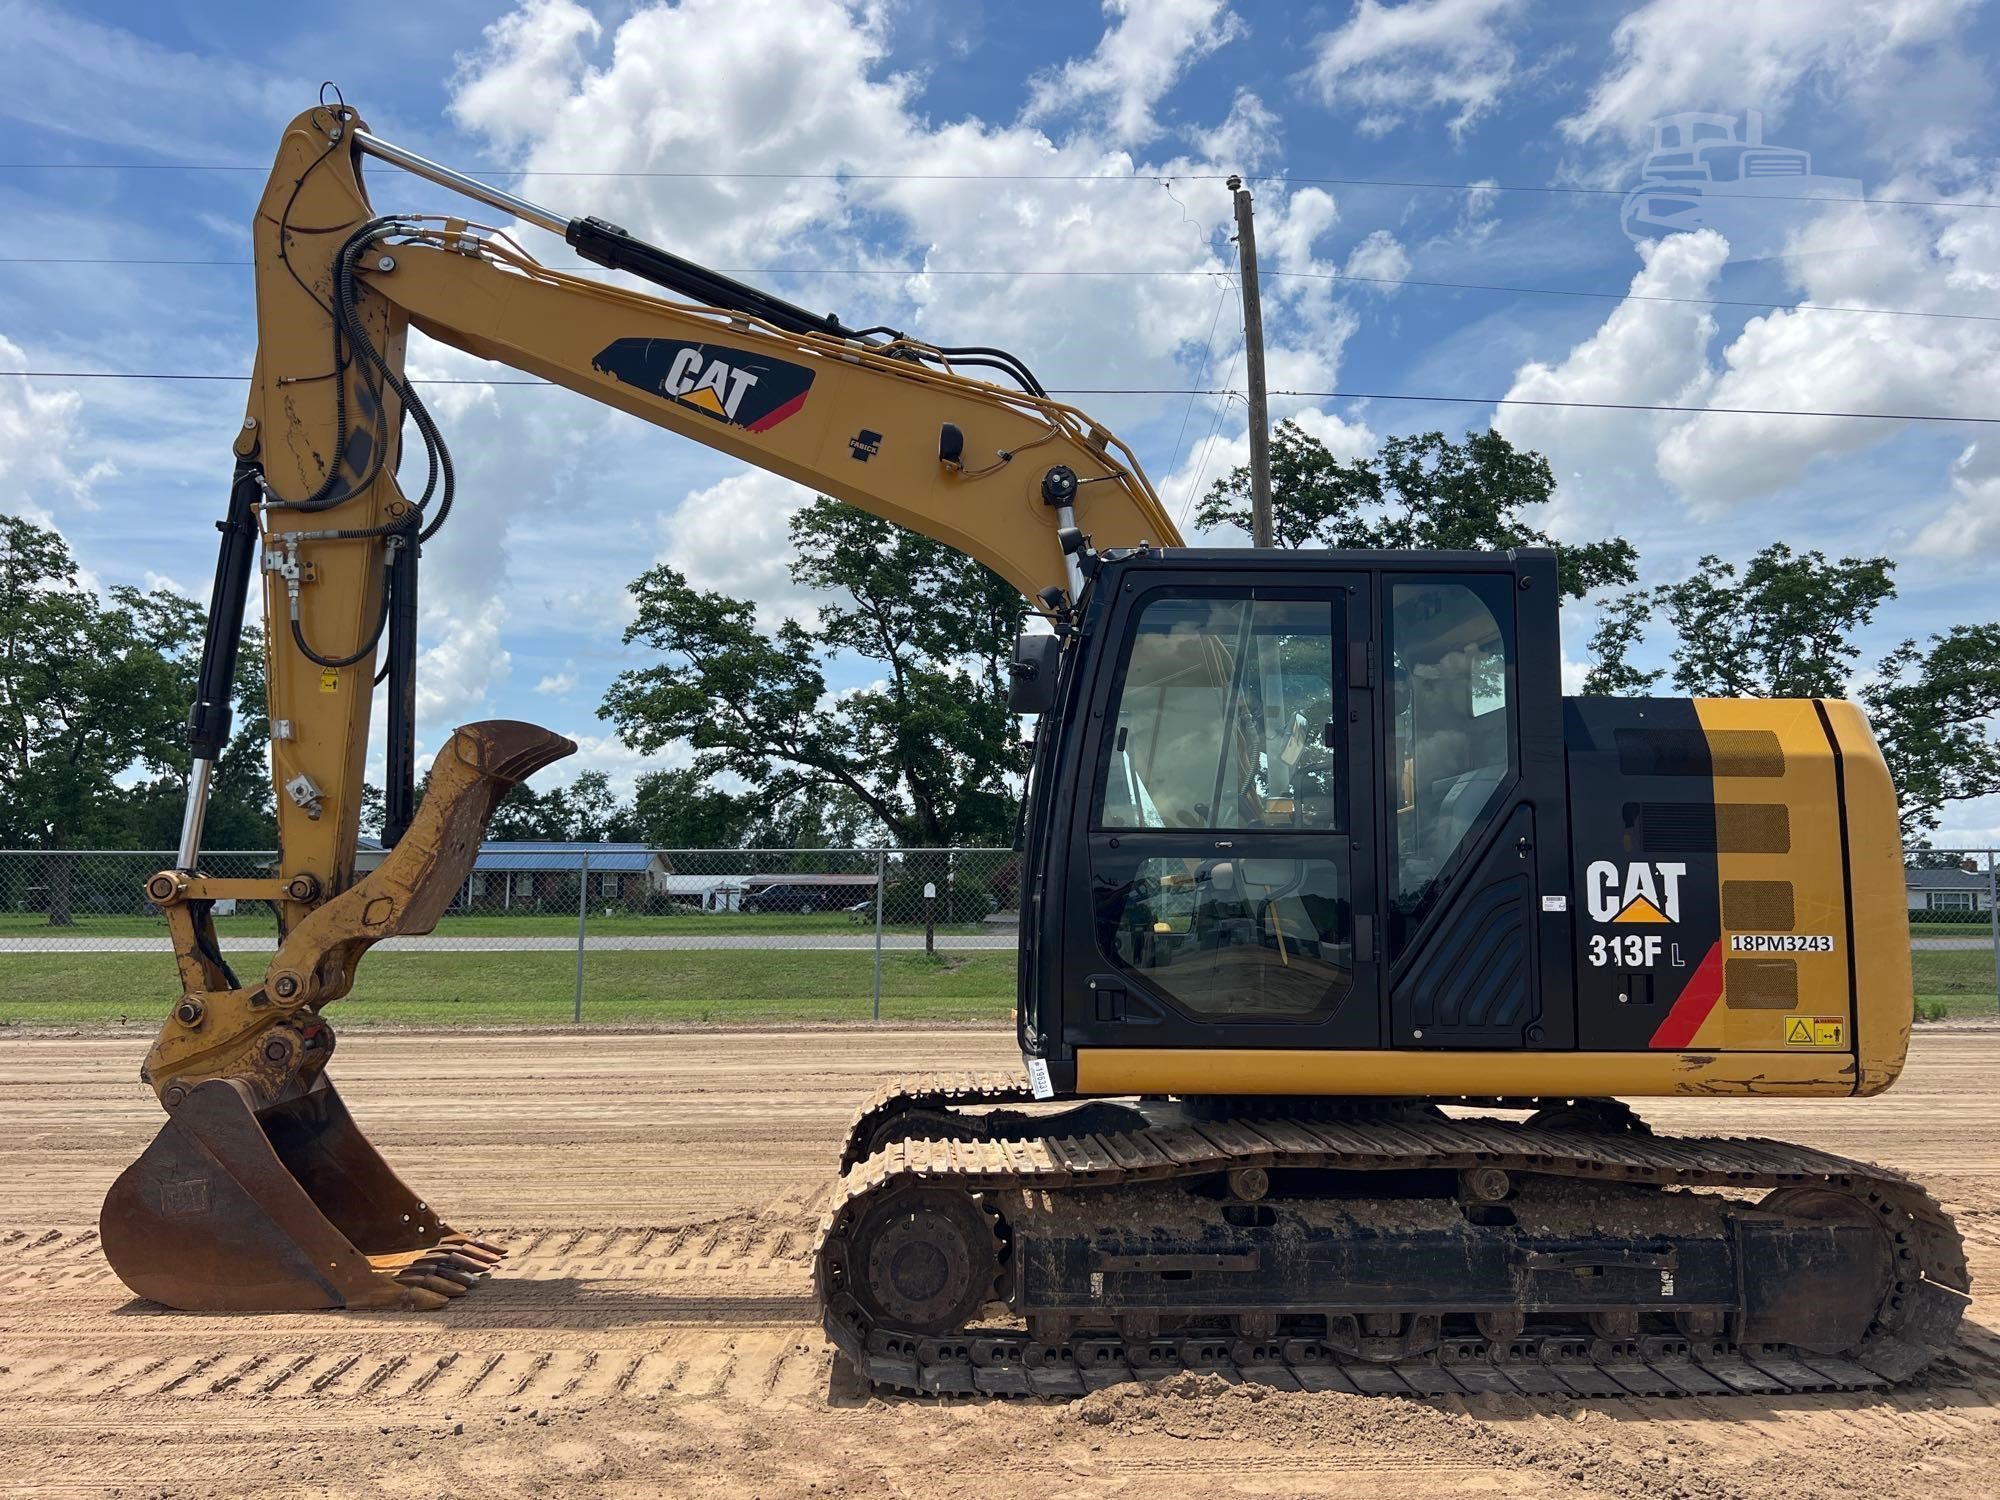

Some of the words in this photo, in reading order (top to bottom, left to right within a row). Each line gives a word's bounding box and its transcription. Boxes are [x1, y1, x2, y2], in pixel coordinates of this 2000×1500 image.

[665, 348, 759, 420] CAT
[850, 440, 877, 454] FABICK
[1586, 860, 1686, 923] CAT
[1588, 935, 1662, 967] 313F
[1671, 942, 1685, 967] L
[1733, 936, 1831, 951] 18PM3243
